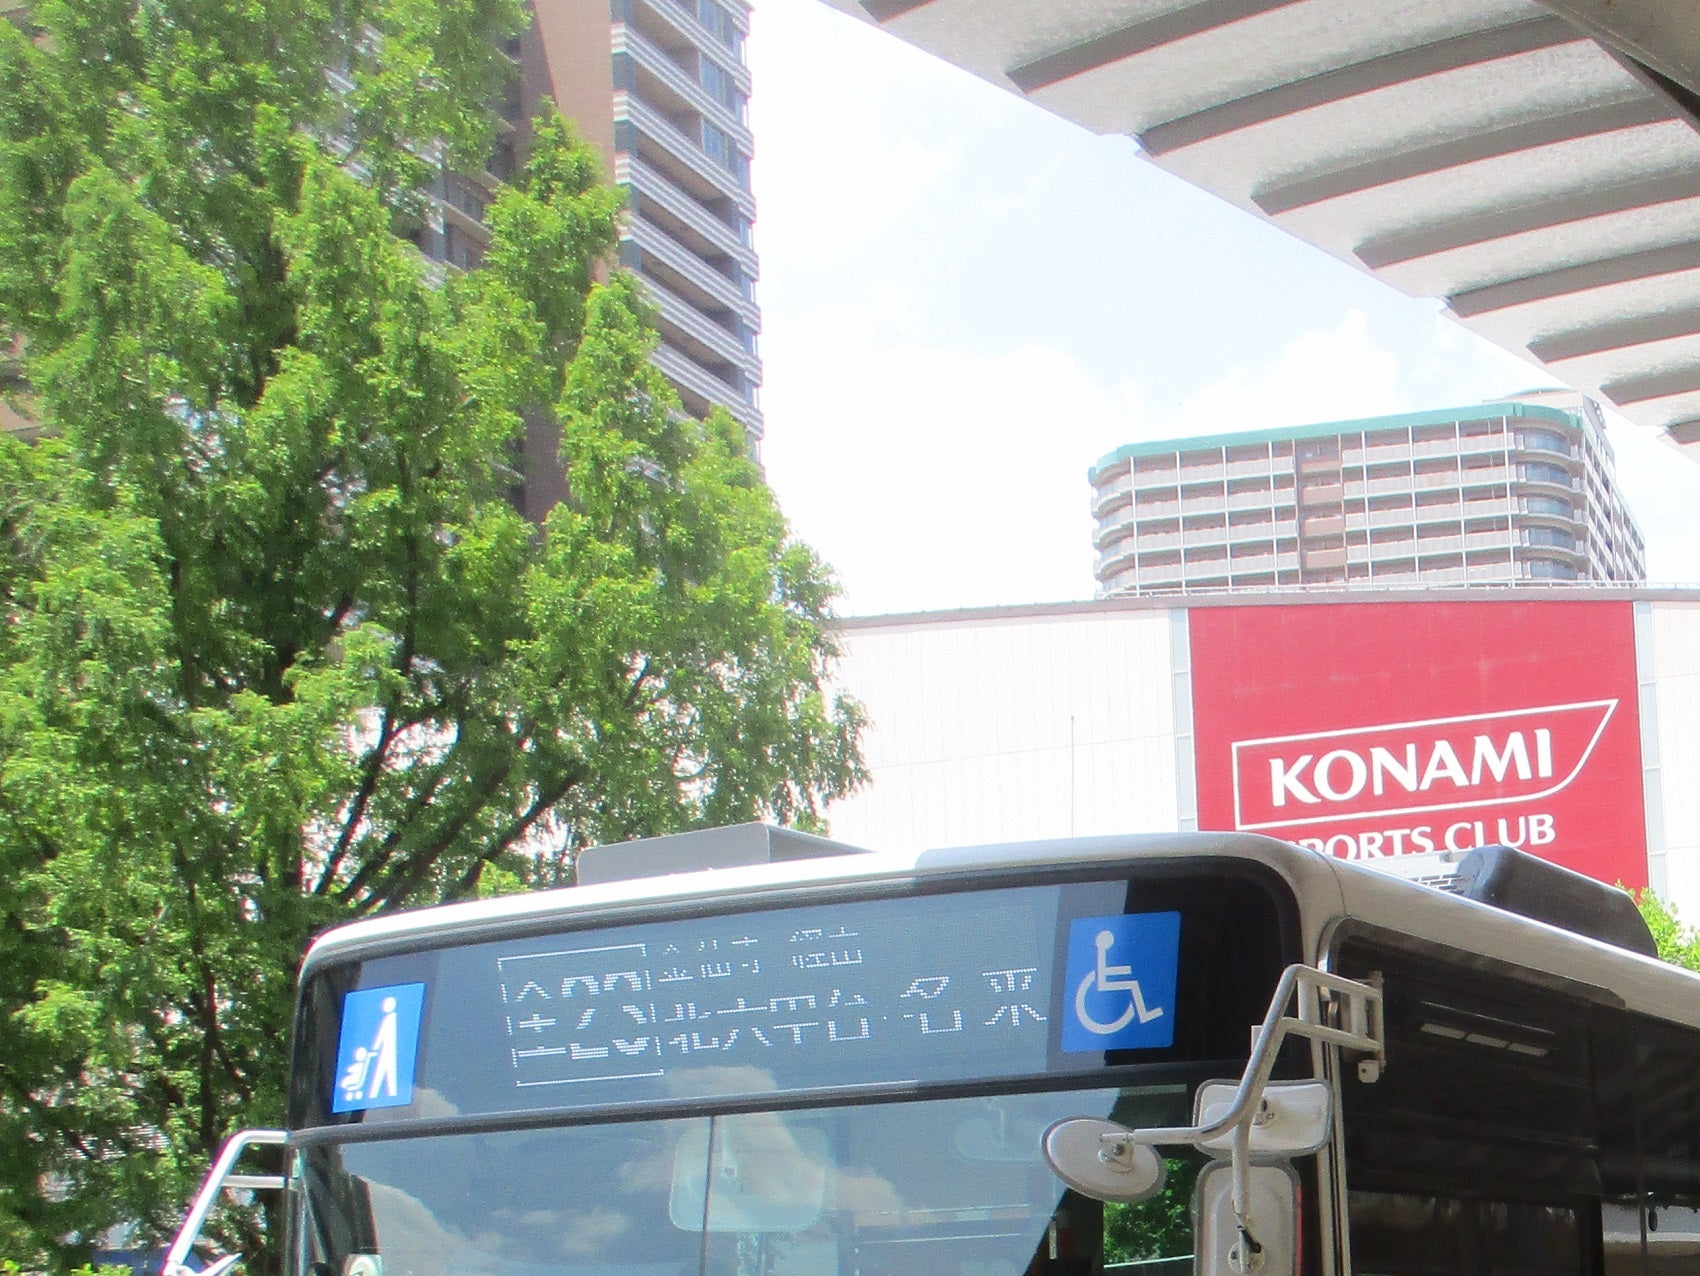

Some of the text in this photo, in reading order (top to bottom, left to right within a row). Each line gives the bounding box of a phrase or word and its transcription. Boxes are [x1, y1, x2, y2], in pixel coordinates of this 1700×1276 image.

[1268, 727, 1553, 807] KONAMI
[1288, 814, 1556, 860] ORTS CLUB
